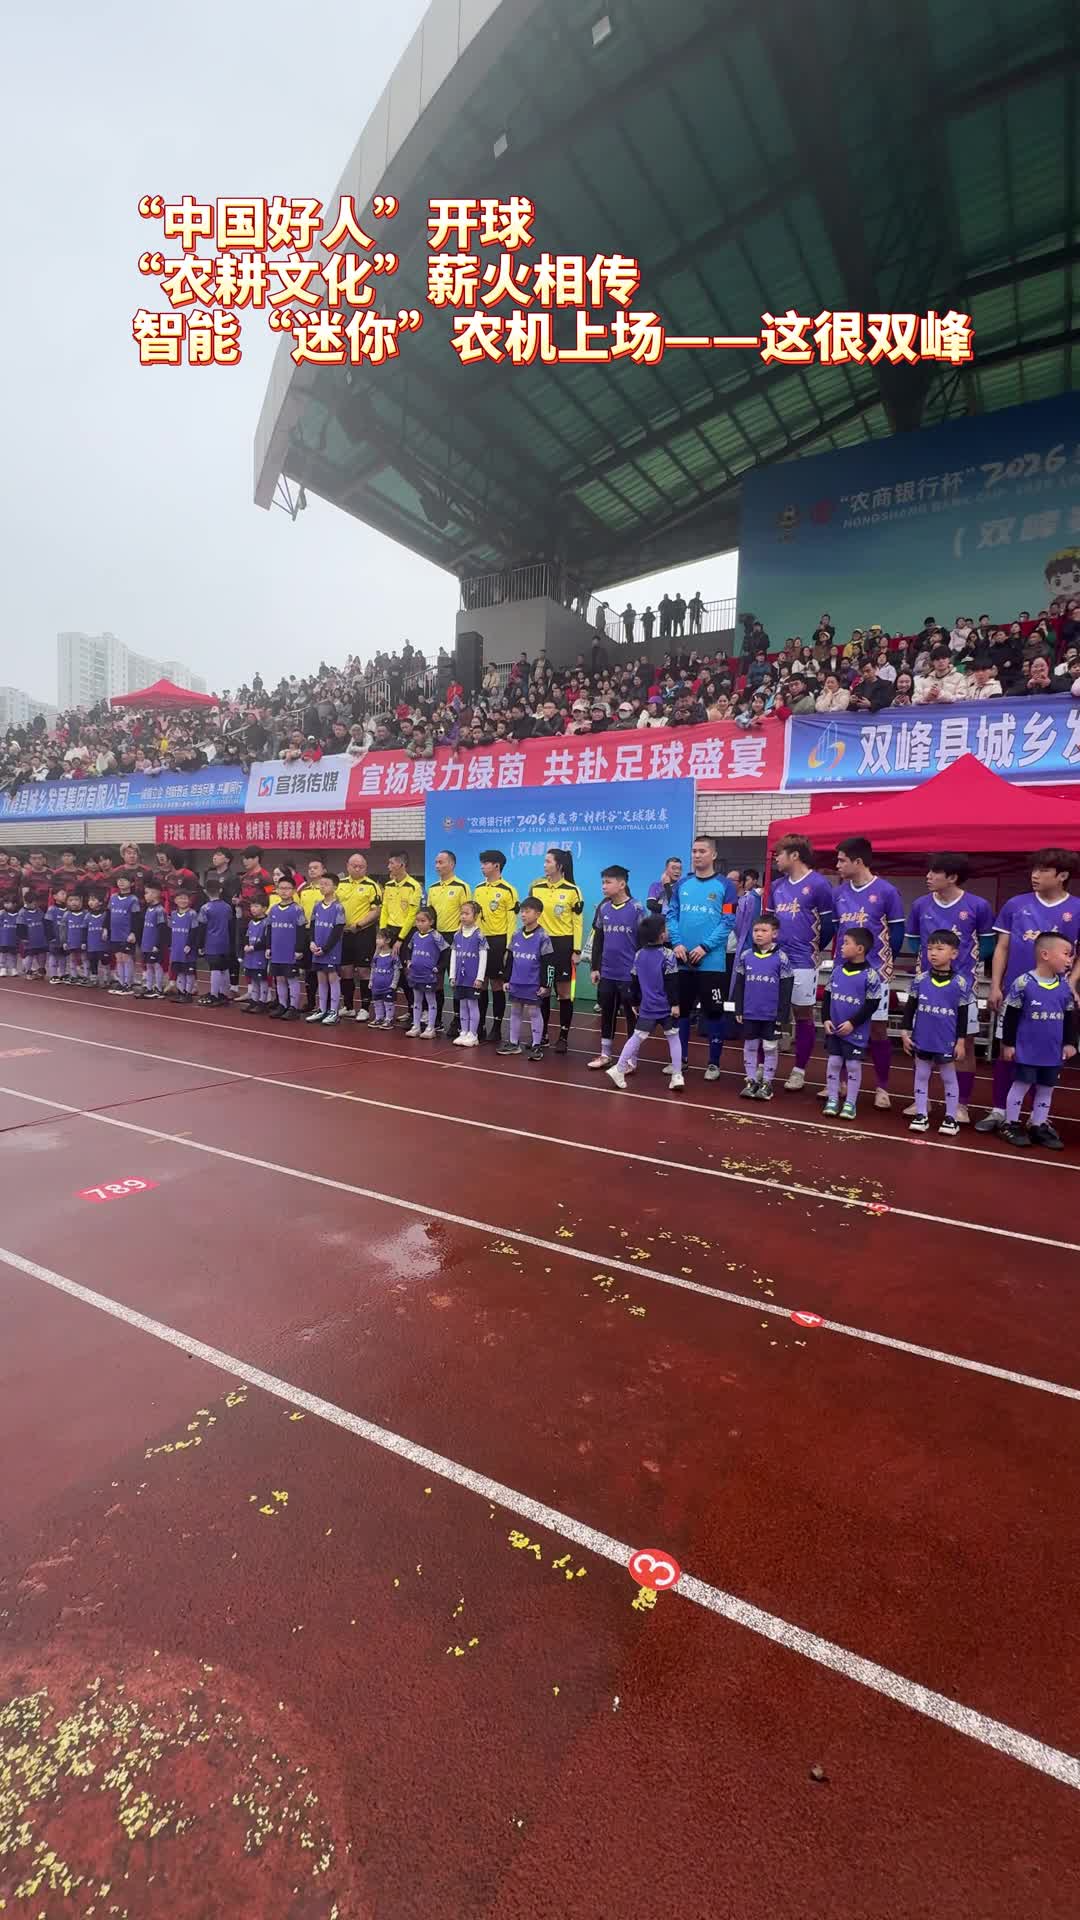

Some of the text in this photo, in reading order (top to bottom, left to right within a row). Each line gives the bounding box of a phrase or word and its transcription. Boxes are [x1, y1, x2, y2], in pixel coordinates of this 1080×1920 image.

[359, 735, 768, 798] 宣扬聚力绿茵 共赴足球盛宴
[275, 769, 340, 797] 宣扬传媒
[711, 988, 722, 1000] 31
[83, 1178, 147, 1200] 789
[796, 1311, 821, 1326] 4
[633, 1555, 674, 1586] 3
